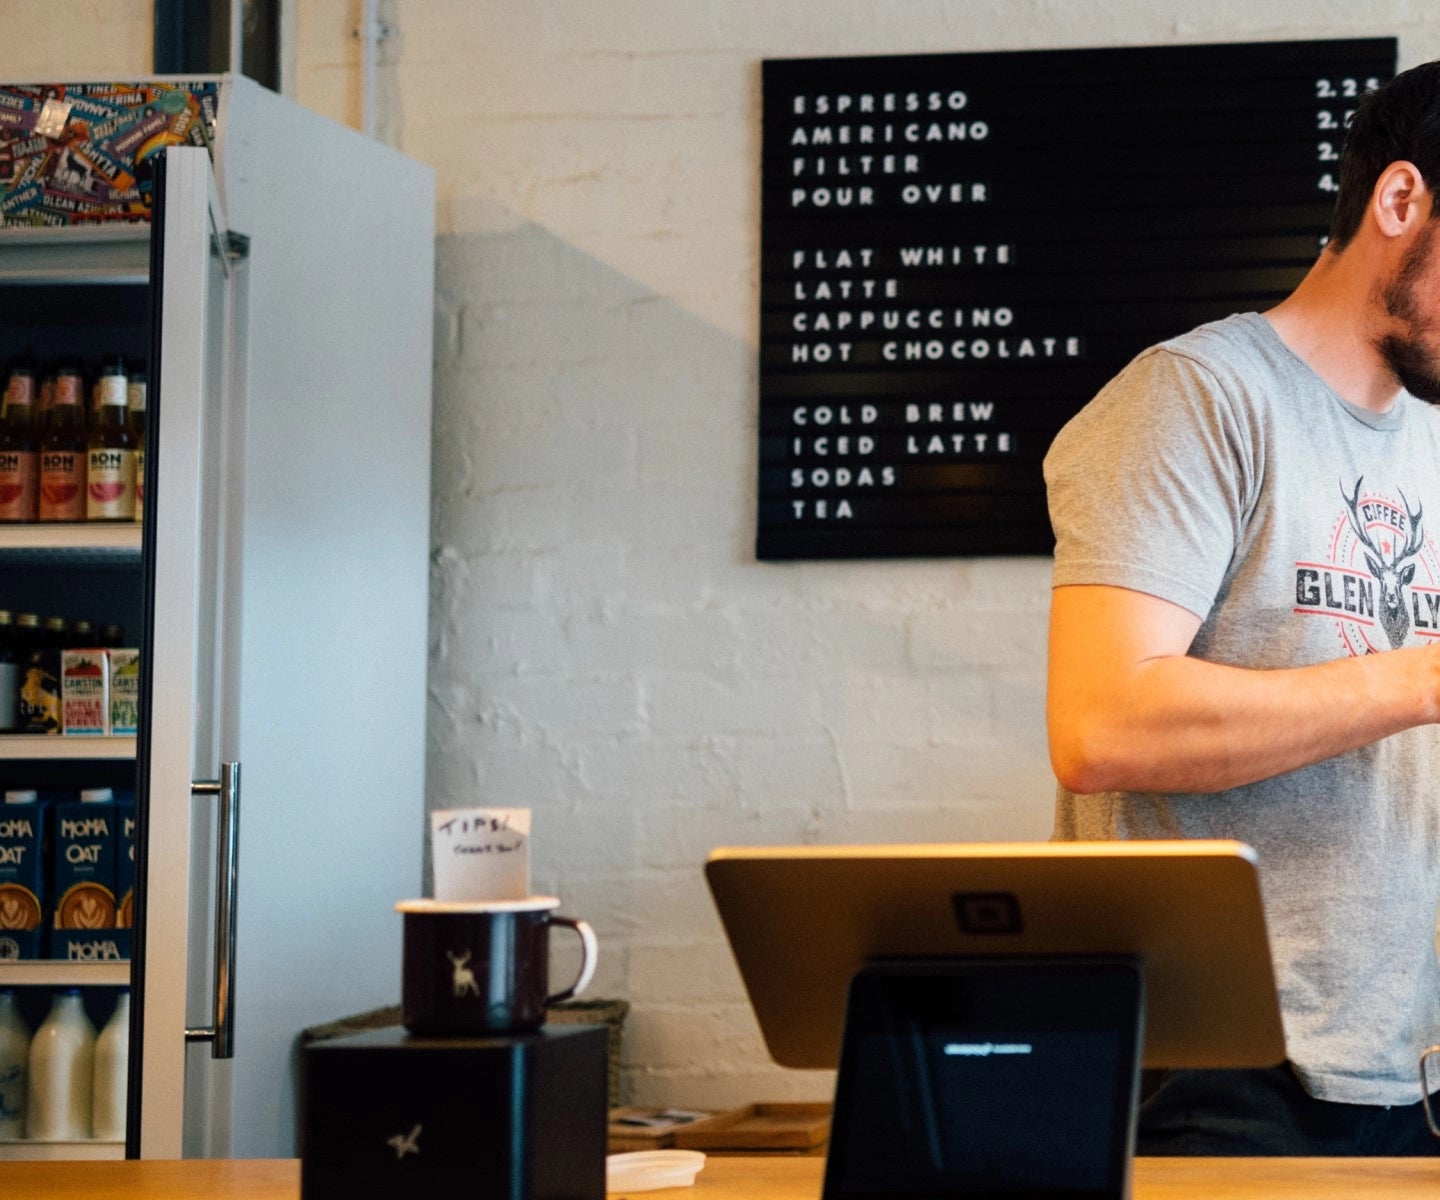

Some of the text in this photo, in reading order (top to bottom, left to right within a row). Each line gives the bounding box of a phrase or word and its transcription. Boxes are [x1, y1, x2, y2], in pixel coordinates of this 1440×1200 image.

[795, 92, 966, 113] ESPRESSO
[792, 122, 988, 144] AMERICANO
[794, 155, 918, 175] FILTER
[793, 184, 986, 206] POUR OVER
[794, 246, 1008, 269] FLAT WHITE
[795, 280, 896, 300] LATTE
[793, 308, 1012, 331] CAPPUCCINO
[793, 338, 1078, 362] HOT CHOCOLATE
[794, 403, 993, 425] COLD BREW
[795, 434, 1010, 455] ICED LATTE
[44, 456, 74, 466] BON
[91, 453, 121, 465] BON
[792, 467, 895, 487] SODAS
[793, 500, 852, 519] TEA
[1296, 568, 1375, 618] GLEN
[112, 711, 138, 726] PEA
[61, 818, 109, 839] MOMA
[66, 844, 102, 864] OAT
